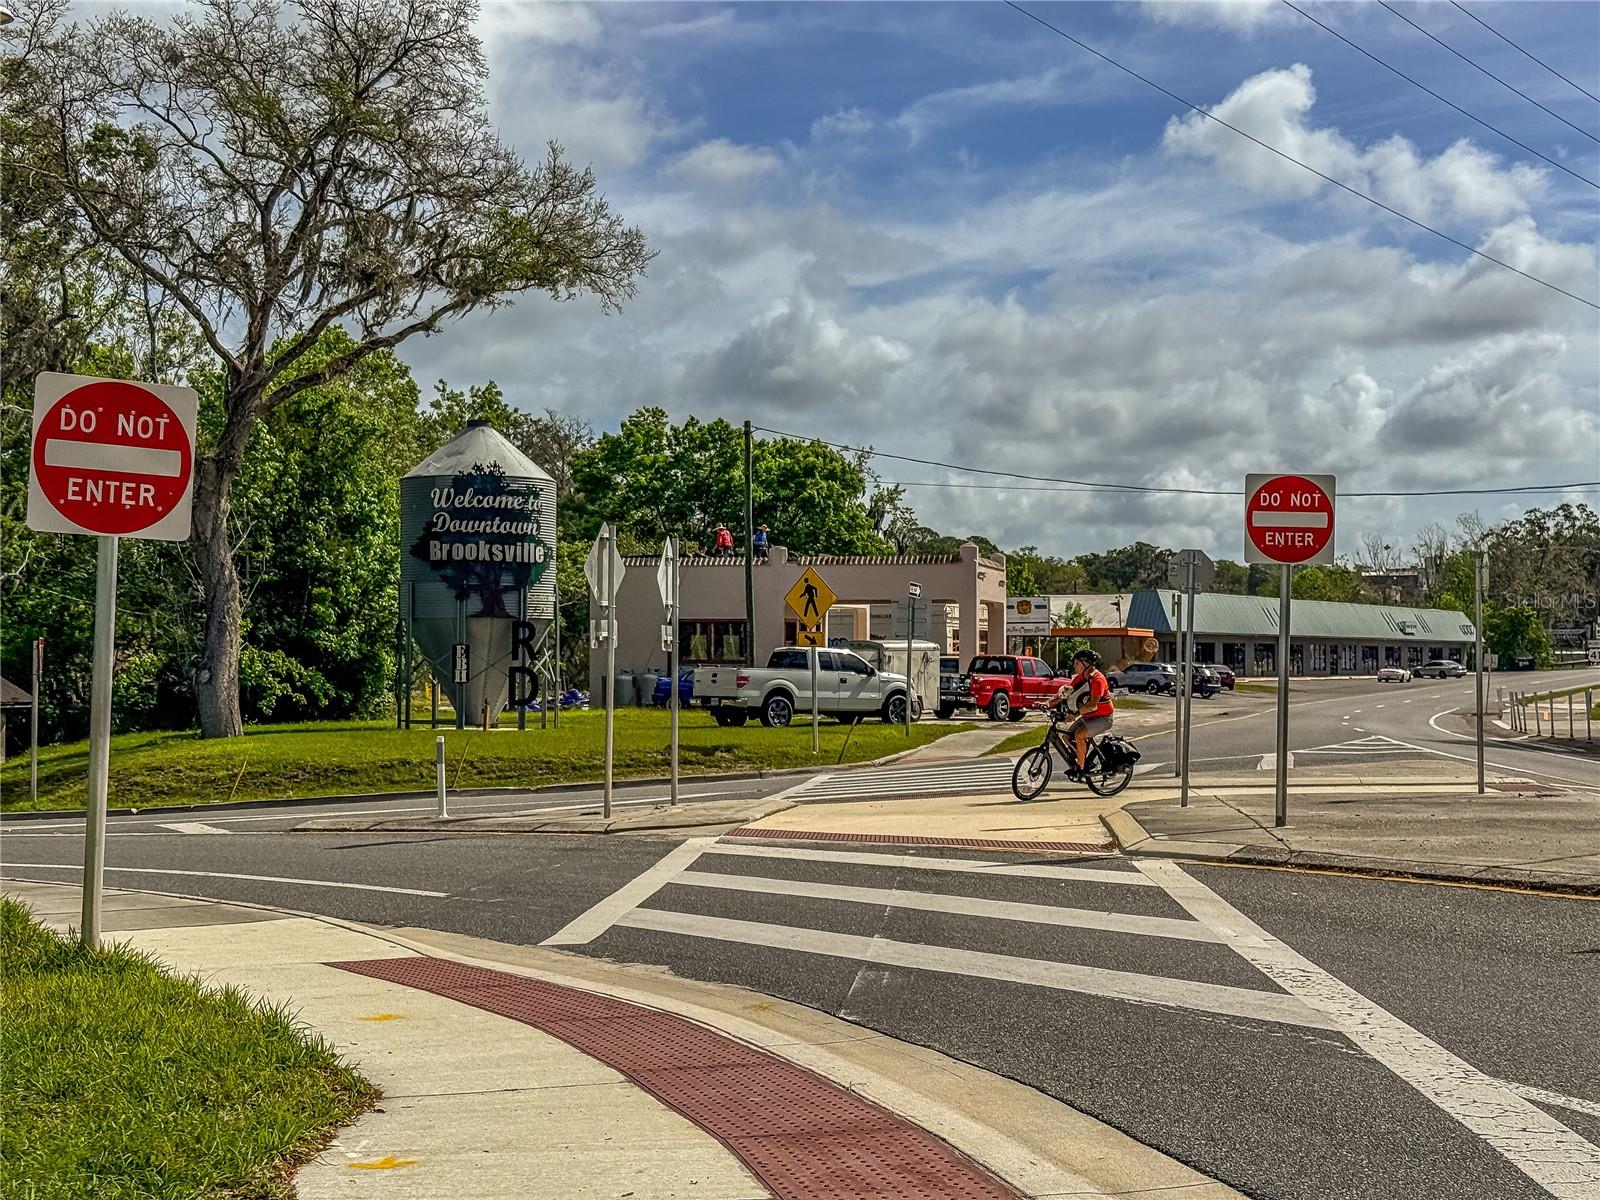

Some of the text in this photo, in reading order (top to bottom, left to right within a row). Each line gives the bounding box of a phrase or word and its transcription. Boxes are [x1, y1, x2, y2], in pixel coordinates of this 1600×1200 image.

[60, 407, 170, 440] DO NOT
[67, 477, 155, 507] ENTER
[431, 488, 542, 511] Welcome to
[1260, 492, 1321, 507] DO NOT
[432, 511, 539, 535] Downtown
[1265, 531, 1314, 547] ENTER
[429, 540, 545, 564] Brooksville
